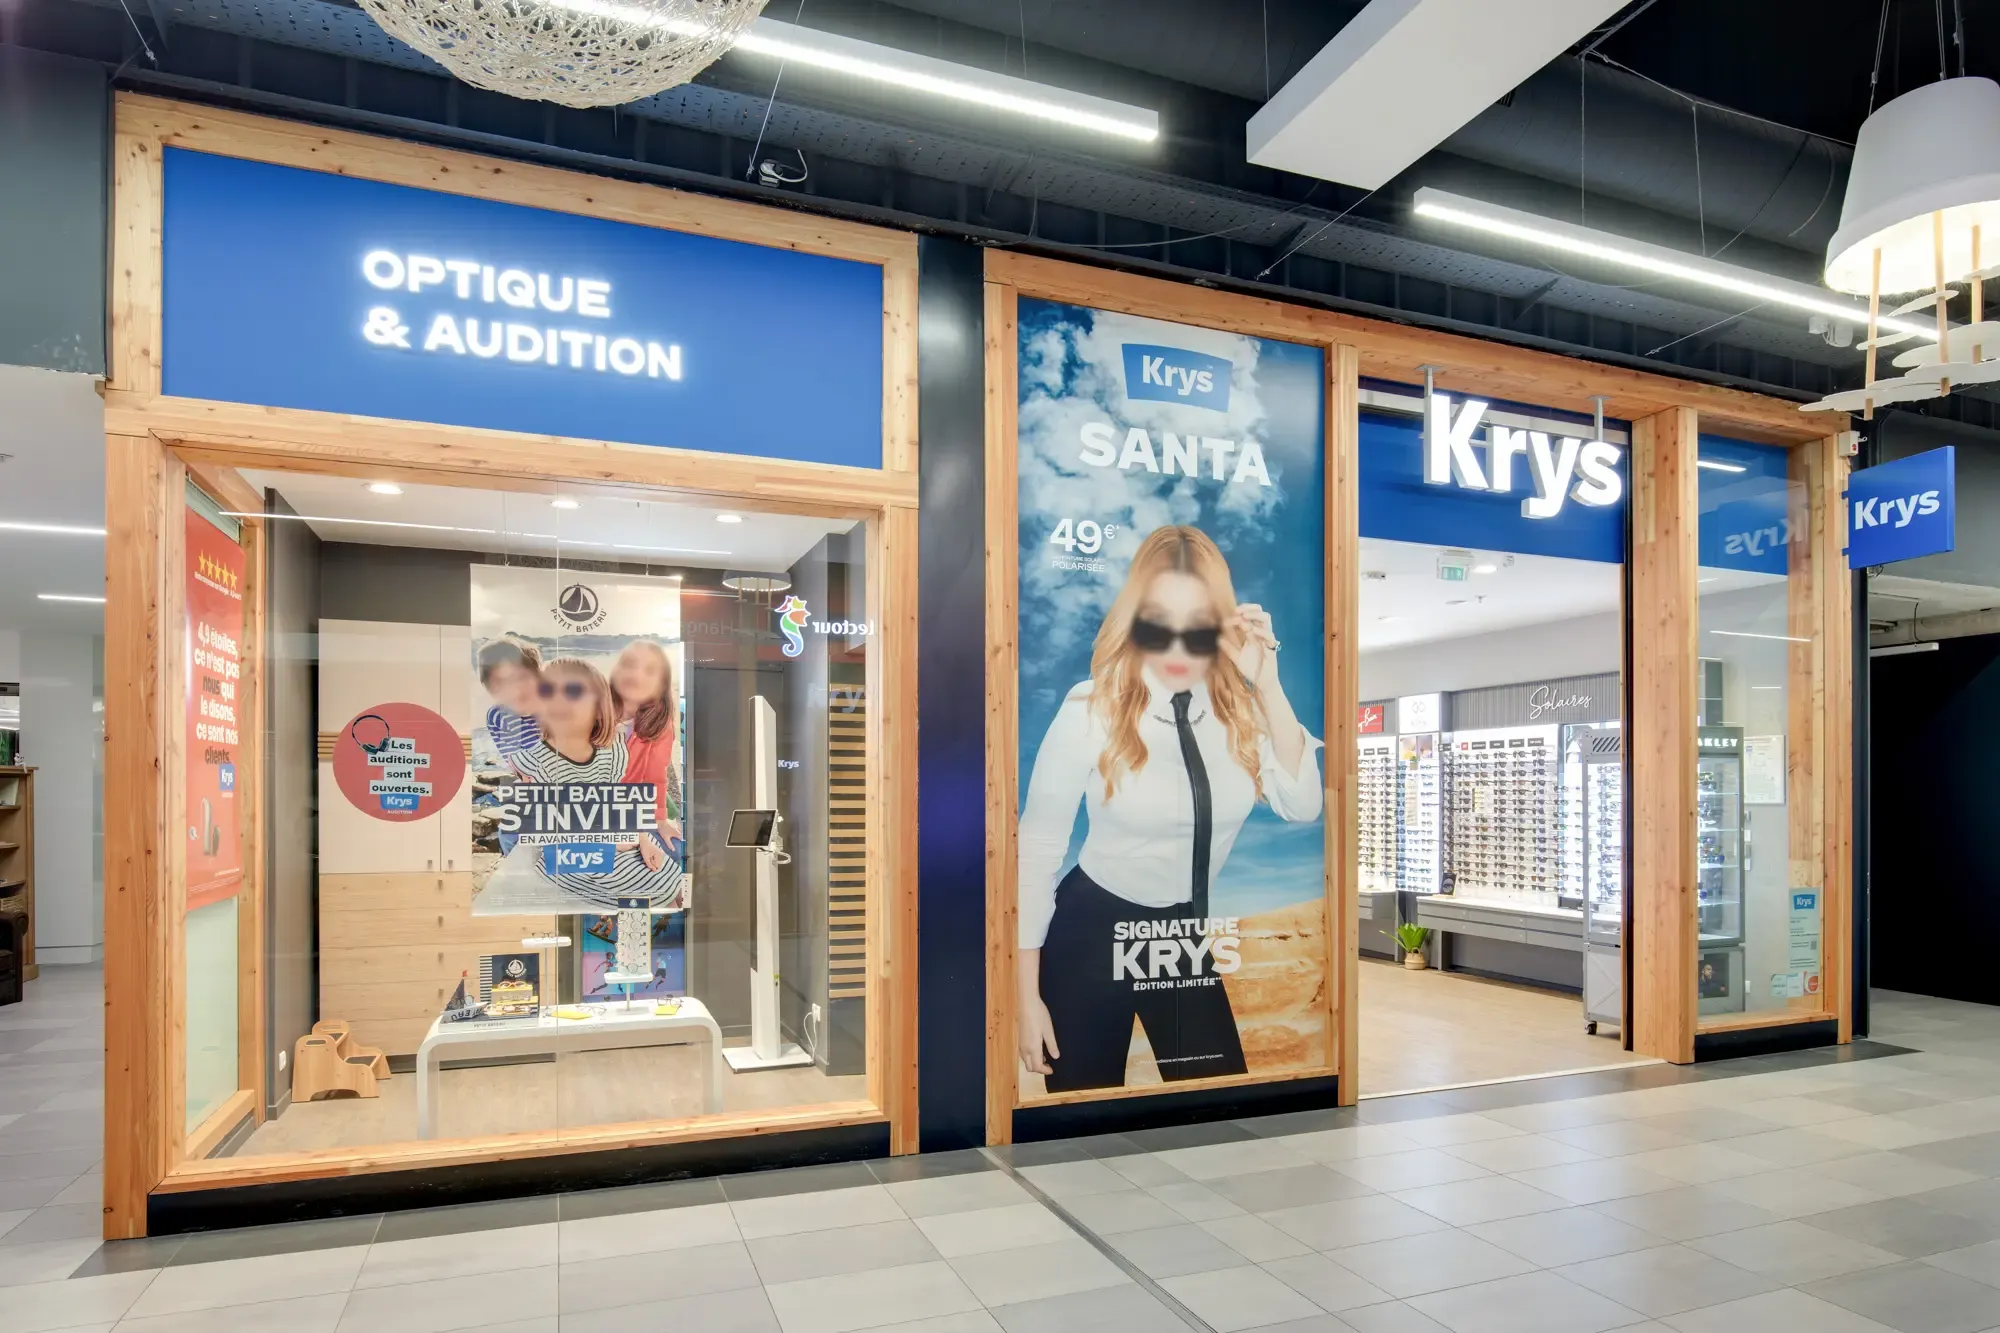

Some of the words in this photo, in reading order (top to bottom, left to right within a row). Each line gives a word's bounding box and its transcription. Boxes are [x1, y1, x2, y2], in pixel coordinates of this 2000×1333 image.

[363, 250, 611, 318] OPTIQUE
[363, 307, 411, 348] &
[424, 314, 682, 380] AUDITION
[1142, 354, 1214, 396] Krys
[1078, 421, 1272, 486] SANTA
[1424, 393, 1622, 519] Krys
[1855, 490, 1940, 530] Krys
[1052, 560, 1105, 572] POLARISÉE
[551, 608, 572, 630] PETIT
[576, 610, 607, 632] BATEAU
[198, 621, 210, 647] 4,9
[210, 627, 238, 660] étoiles,
[225, 660, 240, 680] pas
[203, 676, 220, 696] nous
[221, 681, 235, 702] qui
[201, 695, 208, 716] le
[209, 698, 236, 726] disons,
[1530, 685, 1592, 719] Solaires
[196, 721, 207, 740] ce
[207, 725, 225, 743] sont
[225, 728, 239, 745] nos
[1698, 738, 1738, 747] AKLEY
[205, 746, 232, 765] clients.
[391, 740, 413, 750] Les
[370, 755, 428, 765] auditions
[778, 760, 800, 769] Krys
[386, 770, 412, 779] sont
[371, 784, 430, 794] ouvertes.
[499, 785, 565, 802] PETIT
[569, 785, 658, 802] BATEAU
[386, 796, 413, 807] Krys
[499, 803, 659, 832] S'INVITE
[520, 835, 536, 844] EN
[557, 849, 604, 869] Krys
[1796, 896, 1813, 907] Krys
[1113, 917, 1240, 941] SIGNATURE
[1113, 936, 1242, 981] KRYS
[1133, 980, 1174, 991] ÉDITION
